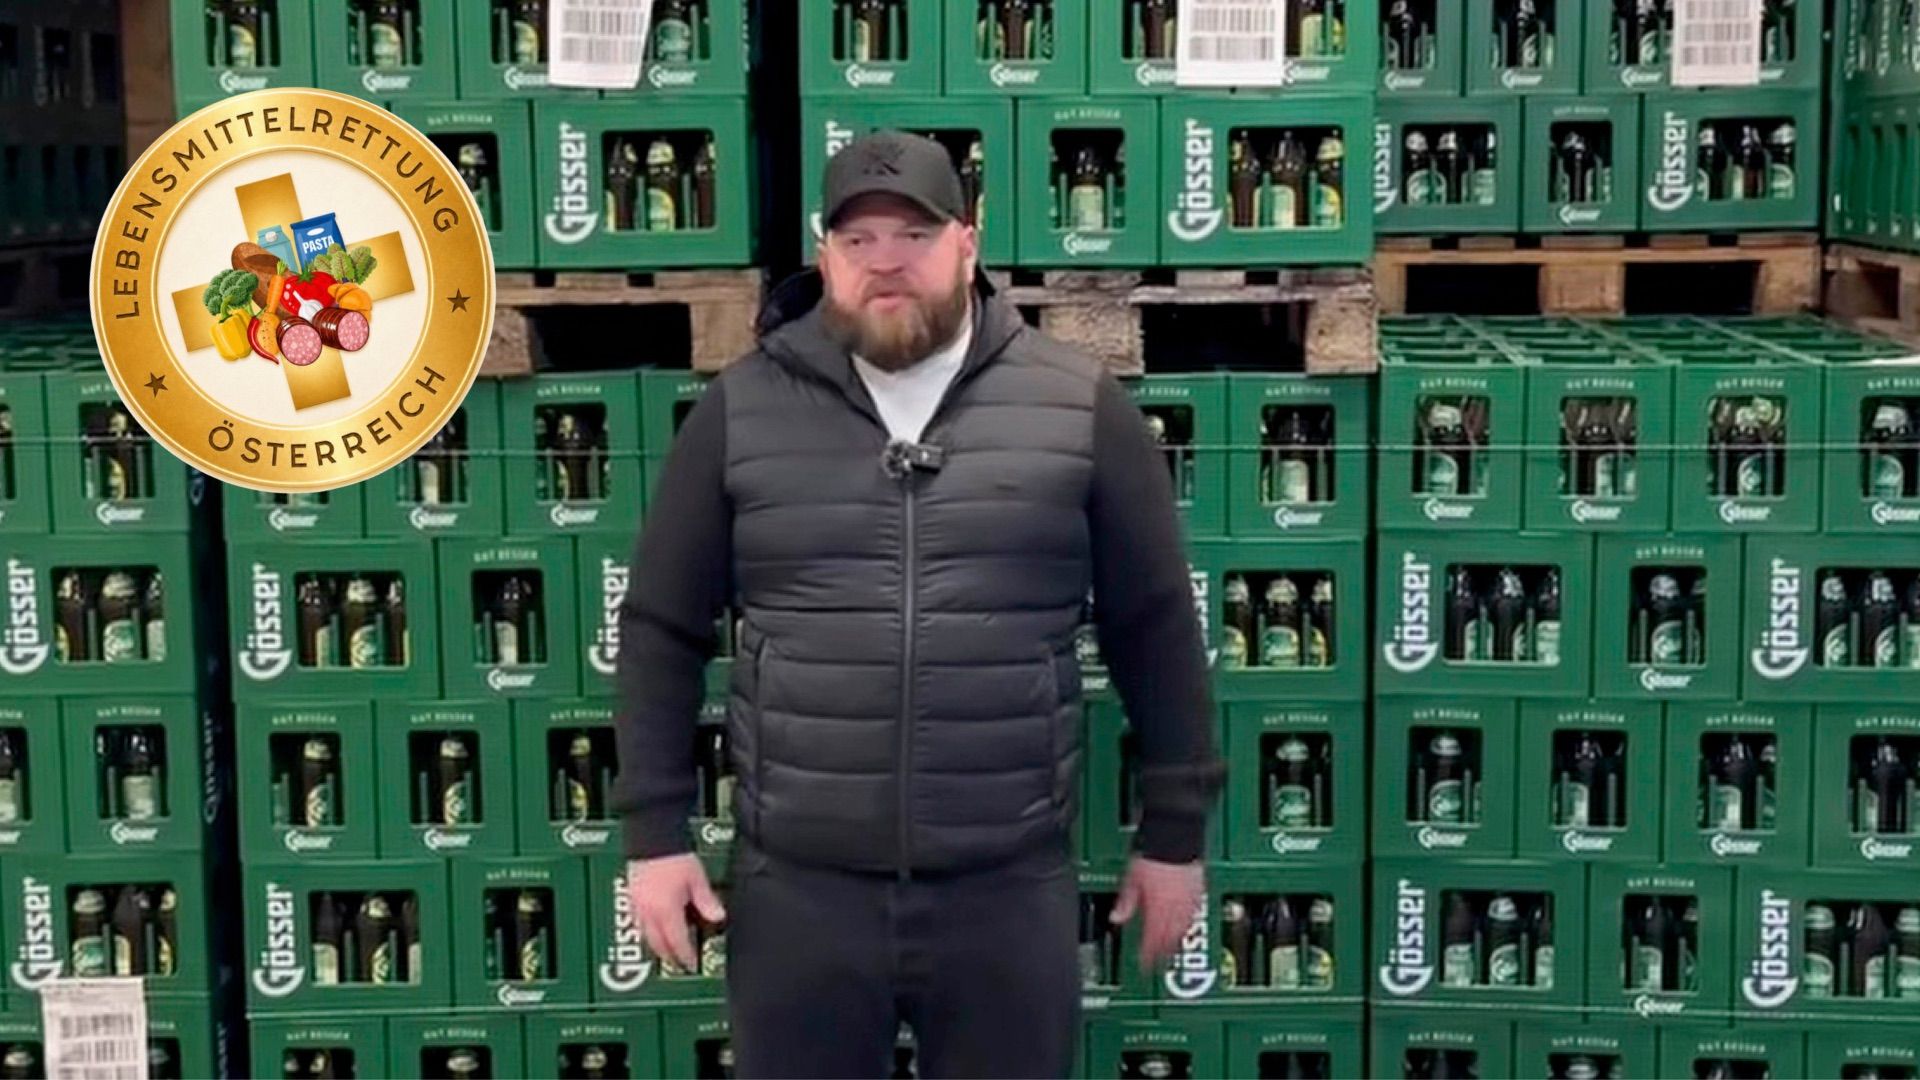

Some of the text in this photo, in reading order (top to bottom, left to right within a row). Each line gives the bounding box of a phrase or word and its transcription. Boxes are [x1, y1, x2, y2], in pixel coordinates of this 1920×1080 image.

[545, 122, 599, 244] Gösser
[1168, 118, 1224, 241] Gösser
[1647, 111, 1693, 211] Gösser
[0, 559, 49, 674] Gösser
[239, 563, 292, 680] Gösser
[1384, 552, 1439, 672] Gösser
[1752, 558, 1808, 679] Gösser
[12, 877, 63, 989] Gösser
[253, 883, 305, 996] Gösser
[1380, 879, 1433, 995] Gösser
[1743, 890, 1798, 1007] Gösser
